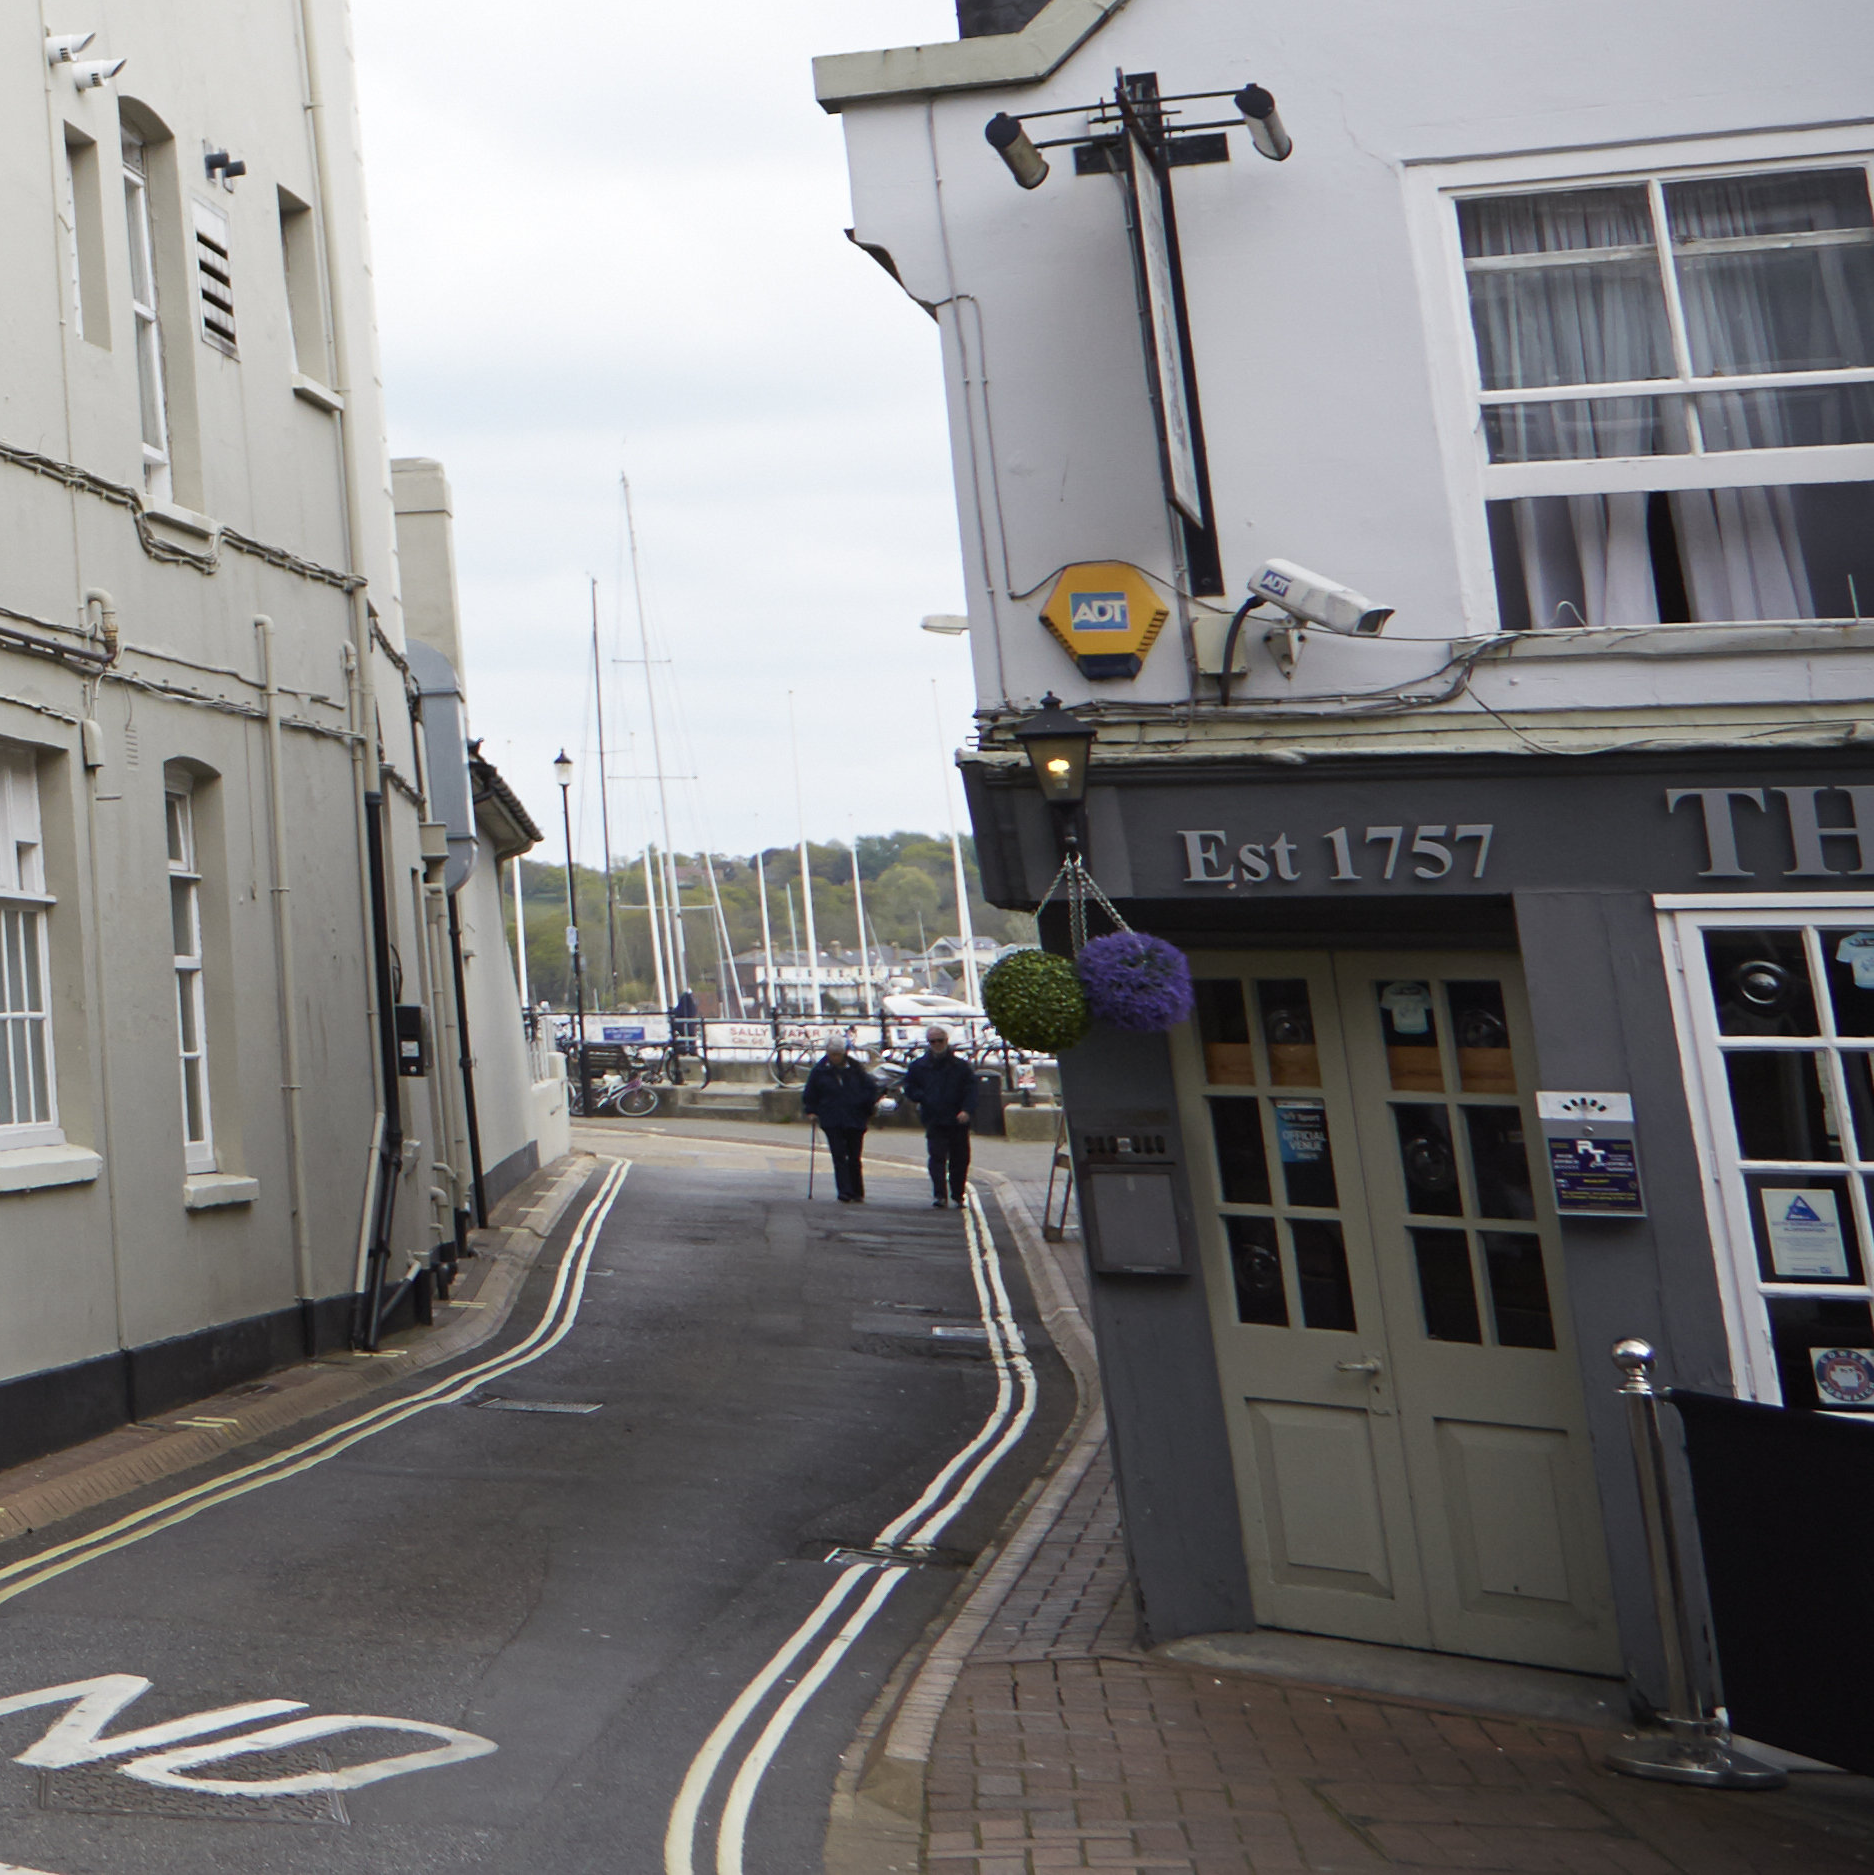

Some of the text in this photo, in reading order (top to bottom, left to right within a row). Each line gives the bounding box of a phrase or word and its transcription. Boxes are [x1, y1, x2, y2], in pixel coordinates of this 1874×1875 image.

[1261, 575, 1292, 594] ADT
[1072, 599, 1127, 624] ADT
[1177, 823, 1494, 883] Est 1757
[729, 1027, 769, 1038] SALLY
[1282, 1130, 1326, 1142] OFFICIAL
